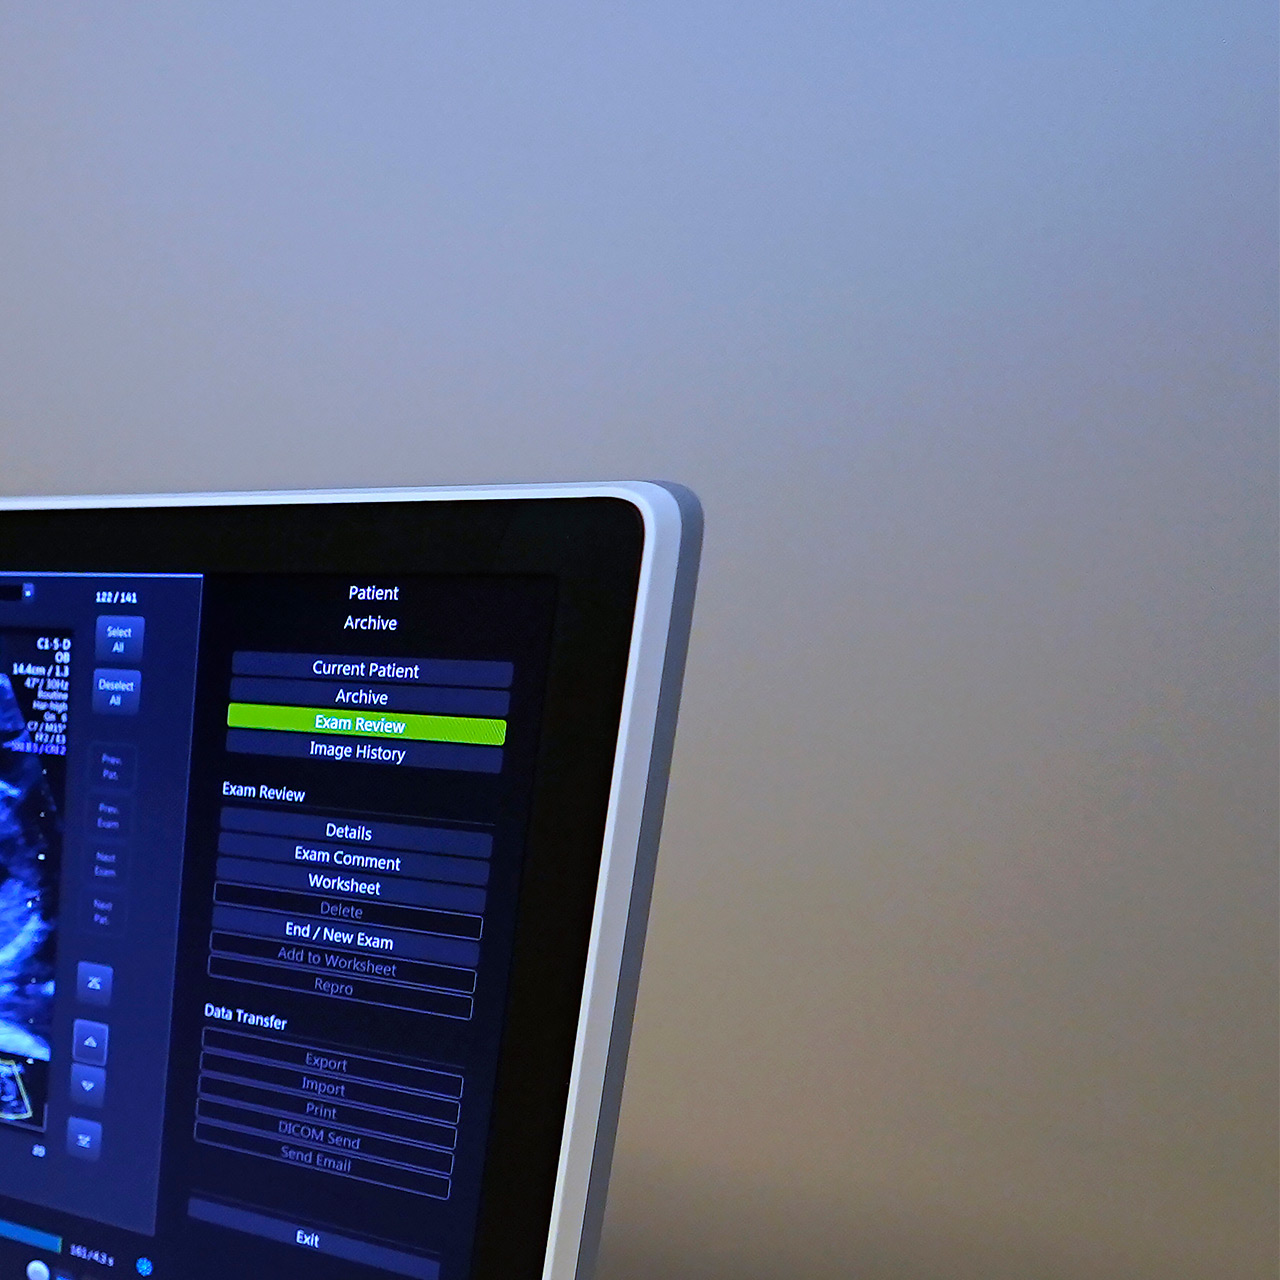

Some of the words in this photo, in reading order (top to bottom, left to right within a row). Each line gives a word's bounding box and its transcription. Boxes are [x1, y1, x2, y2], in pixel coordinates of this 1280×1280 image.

[349, 585, 399, 601] Patient
[107, 626, 132, 638] Select
[343, 615, 397, 631] Archive
[112, 641, 125, 653] All
[312, 660, 366, 677] Current
[369, 663, 420, 679] Patient
[98, 678, 134, 692] Deselect
[109, 695, 122, 706] All
[335, 688, 388, 705] Archive
[315, 715, 351, 731] Exam
[355, 717, 406, 734] Review
[310, 741, 351, 759] Image
[356, 745, 406, 765] History
[222, 781, 256, 799] Exam
[259, 785, 305, 802] Review
[326, 823, 372, 841] Details
[295, 846, 330, 863] Exam
[333, 851, 401, 872] Comment
[308, 873, 381, 896] Worksheet
[320, 902, 363, 919] Delete
[285, 922, 310, 938] End
[312, 926, 321, 941] /
[323, 927, 354, 945] New
[357, 932, 393, 950] Exam
[278, 947, 304, 964] Add
[307, 951, 321, 966] to
[325, 953, 397, 977] Worksheet
[314, 977, 353, 996] Repro
[204, 1003, 233, 1021] Data
[236, 1009, 287, 1031] Transfer
[305, 1052, 348, 1073] Export
[302, 1076, 345, 1097] Import
[306, 1102, 337, 1120] Print
[278, 1120, 324, 1142] DICOM
[327, 1130, 361, 1150] Send
[281, 1146, 313, 1164] Send
[316, 1154, 352, 1173] Email
[296, 1229, 320, 1248] Exit
